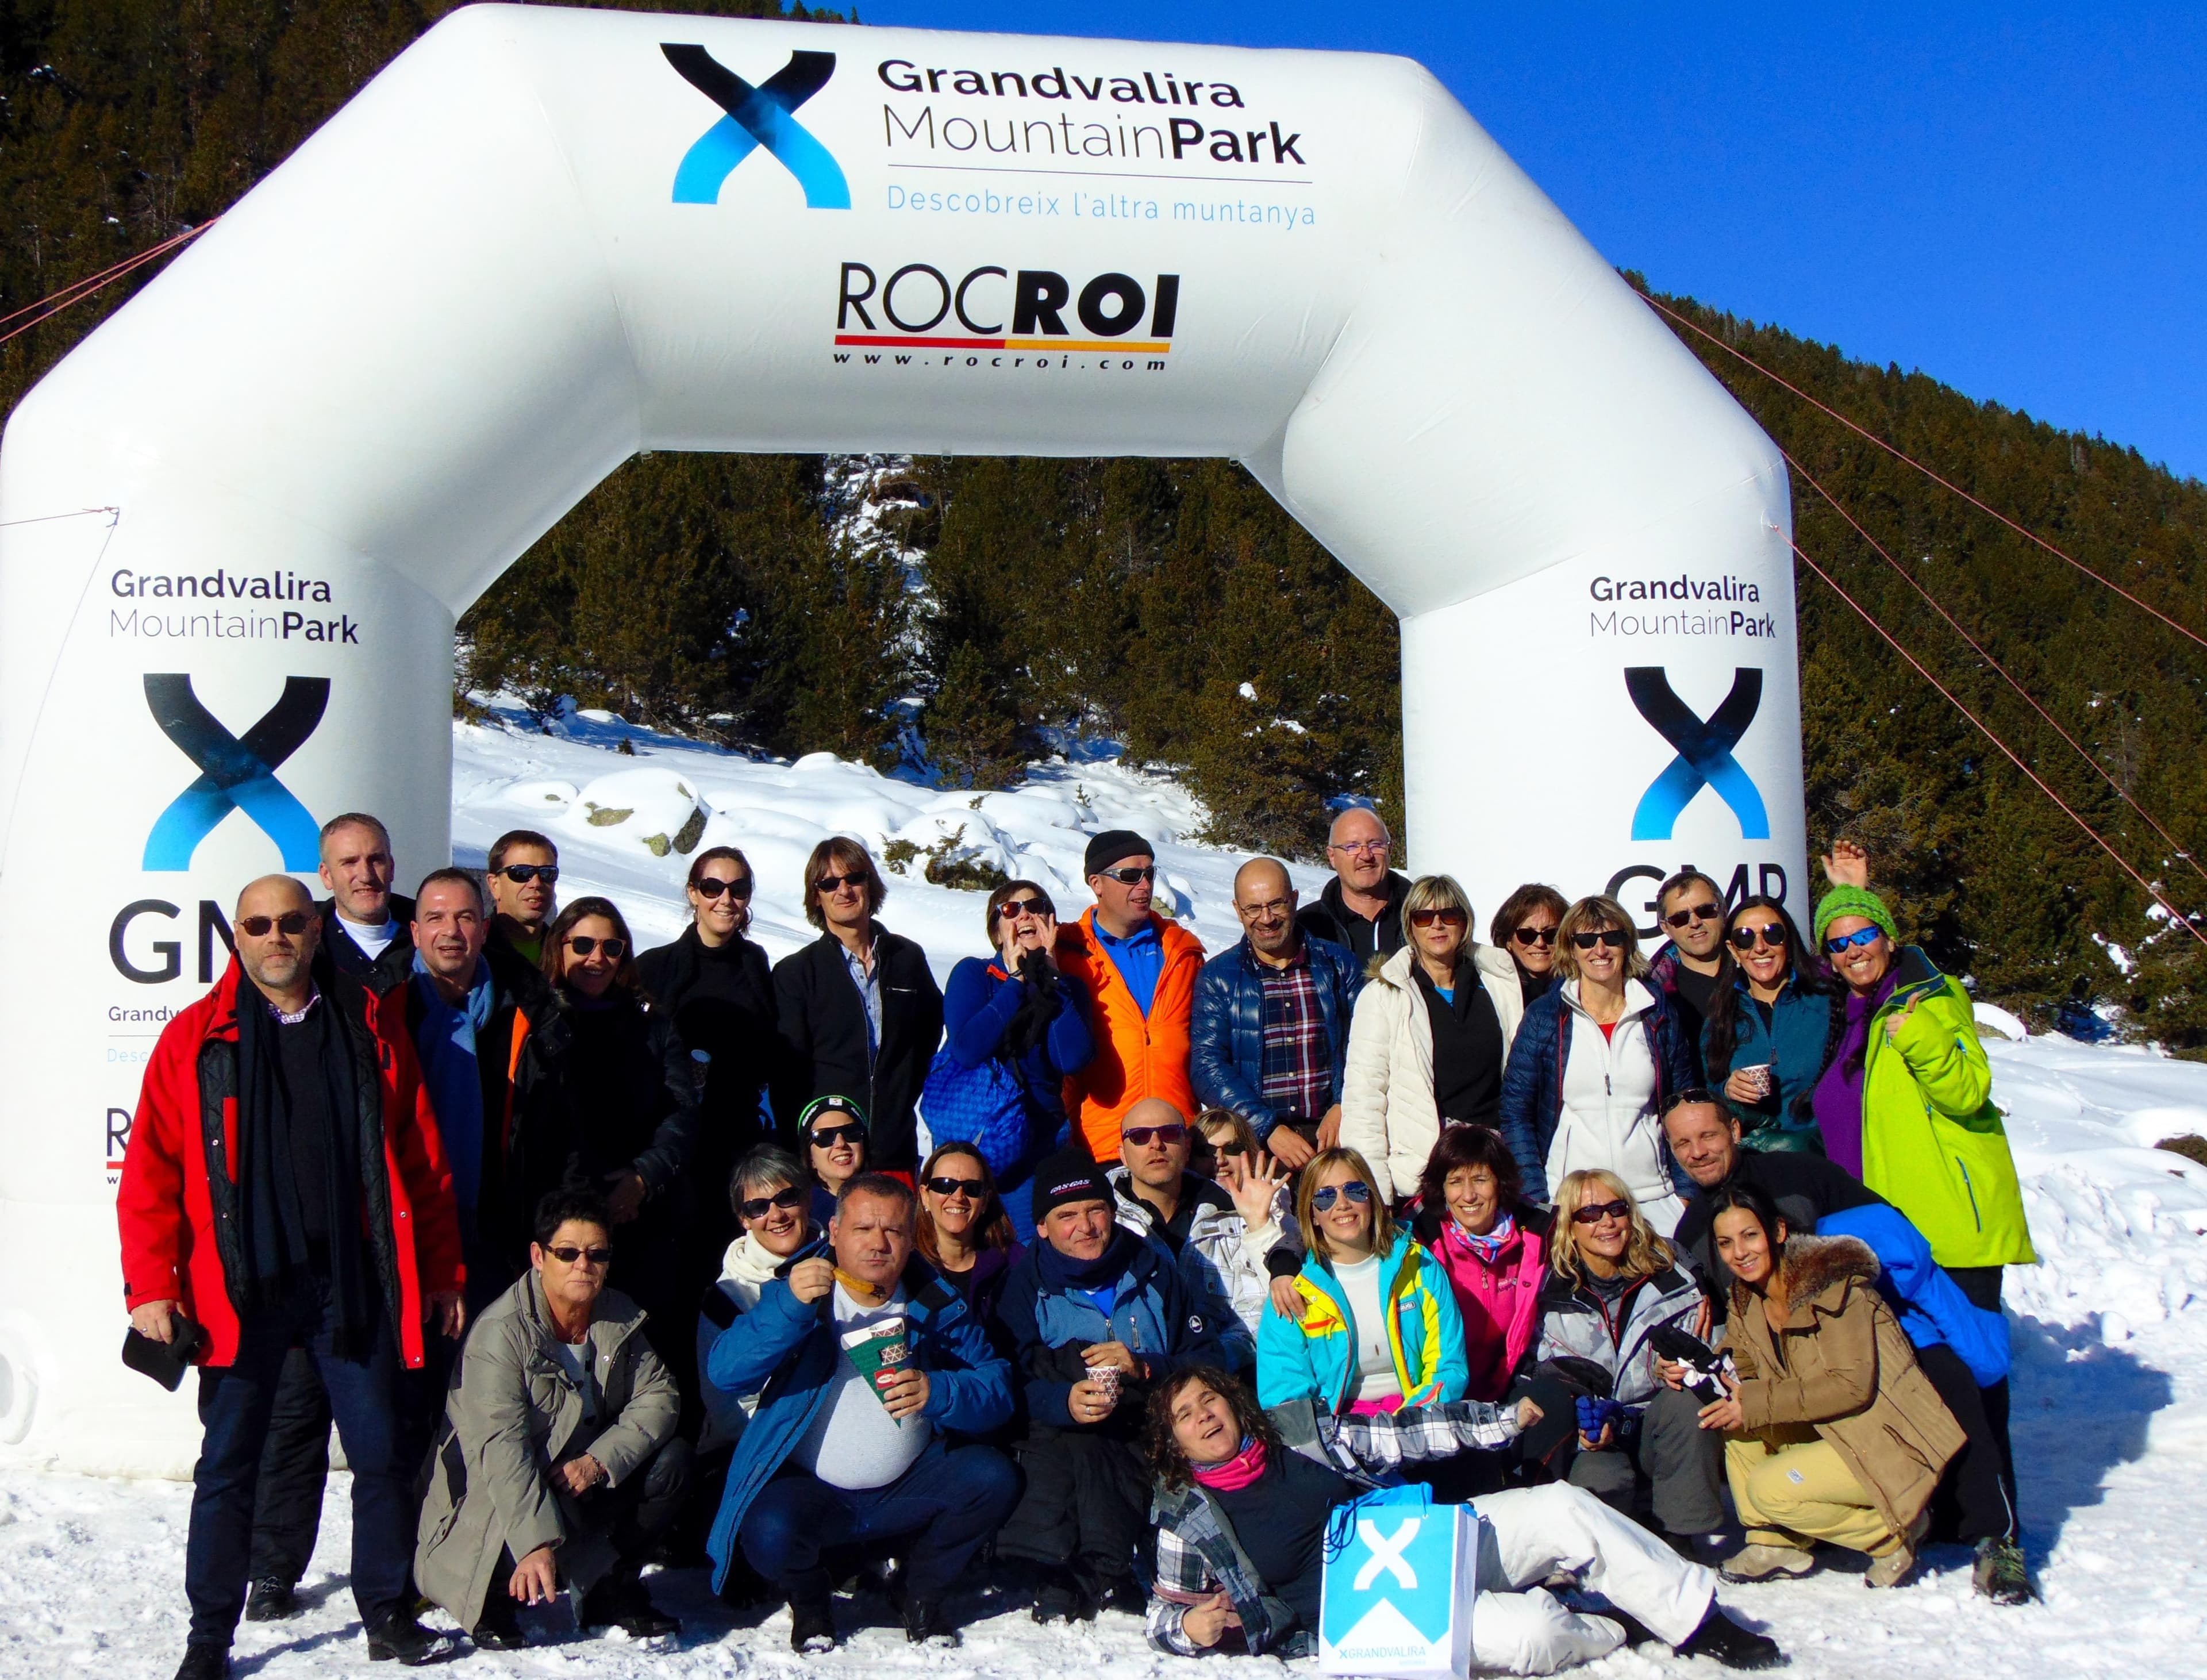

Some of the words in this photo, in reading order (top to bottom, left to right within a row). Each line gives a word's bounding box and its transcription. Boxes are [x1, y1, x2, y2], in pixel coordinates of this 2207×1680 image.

[877, 59, 1245, 109] Grandvalira
[885, 103, 1307, 166] MountainPark
[888, 184, 1060, 216] Descobreix
[1074, 192, 1159, 221] l'altra
[1172, 198, 1316, 230] muntanya
[836, 262, 1181, 337] ROCROI
[833, 352, 1166, 371] www.rocroi.com
[111, 568, 332, 603] Grandvalira
[1589, 574, 1760, 603] Grandvalira
[110, 608, 360, 645] MountainPark
[1590, 609, 1777, 639] MountainPark
